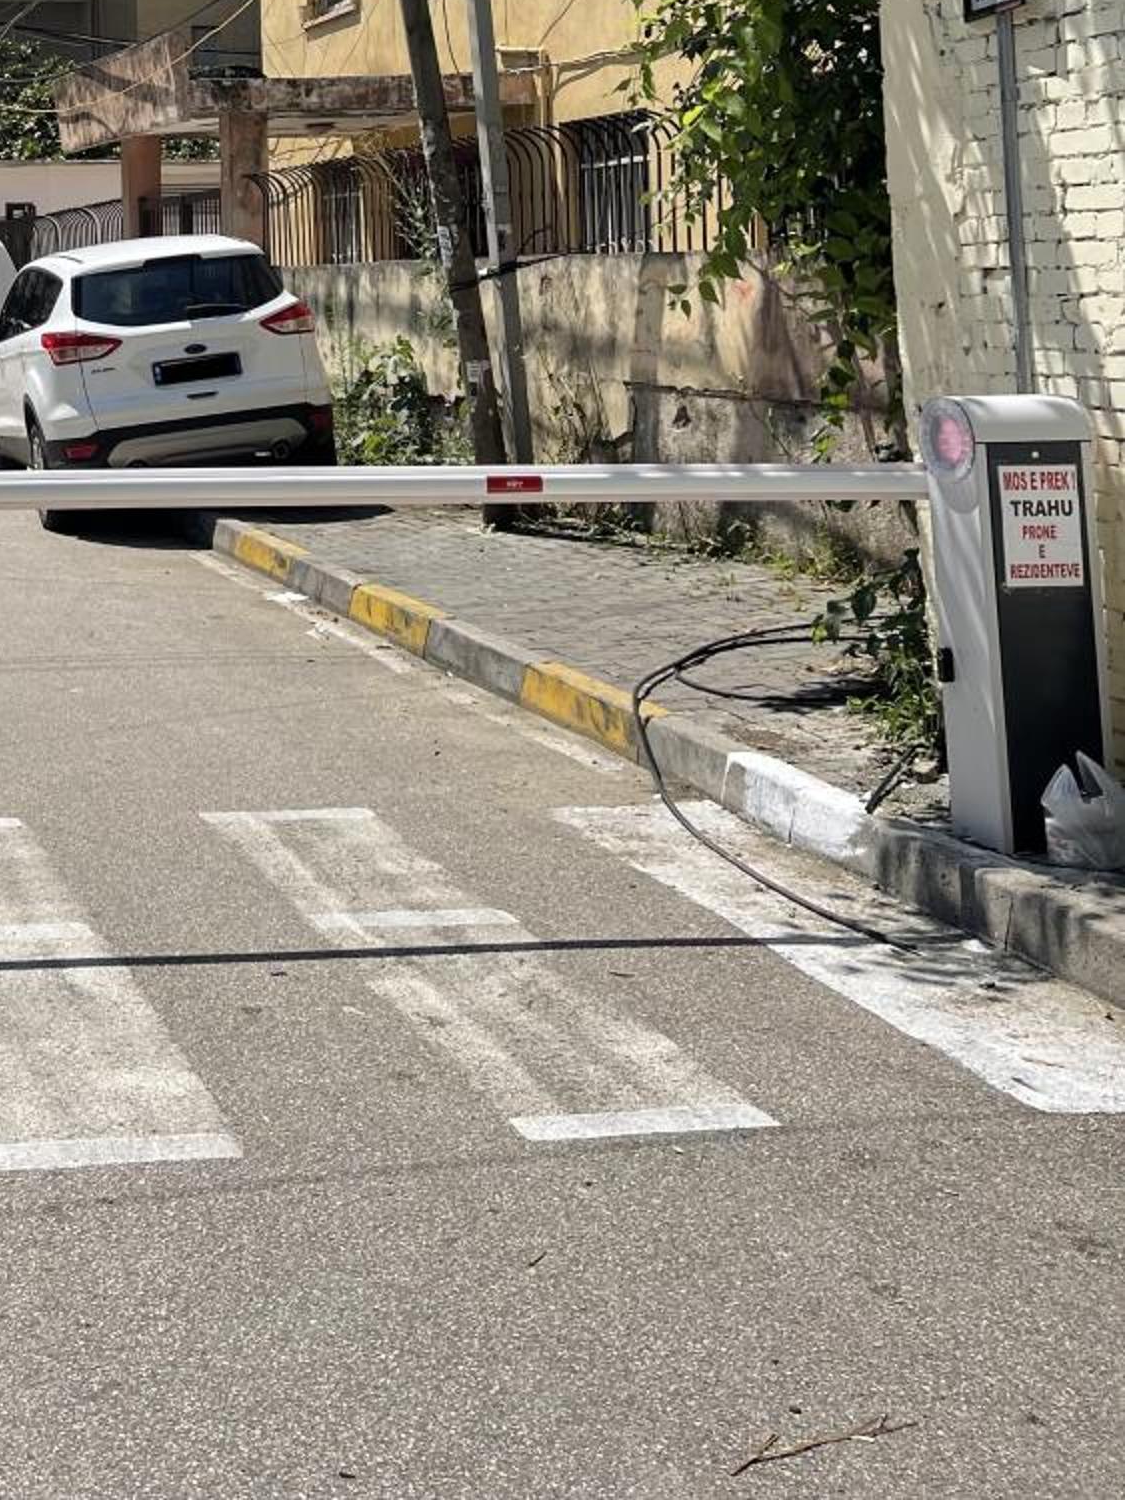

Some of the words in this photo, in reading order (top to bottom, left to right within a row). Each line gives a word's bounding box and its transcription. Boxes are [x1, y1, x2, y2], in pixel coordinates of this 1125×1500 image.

[1002, 471, 1028, 491] MOS
[1030, 471, 1037, 491] E
[1039, 471, 1070, 491] PREK
[1009, 499, 1073, 517] TRAHU
[1038, 544, 1046, 559] E
